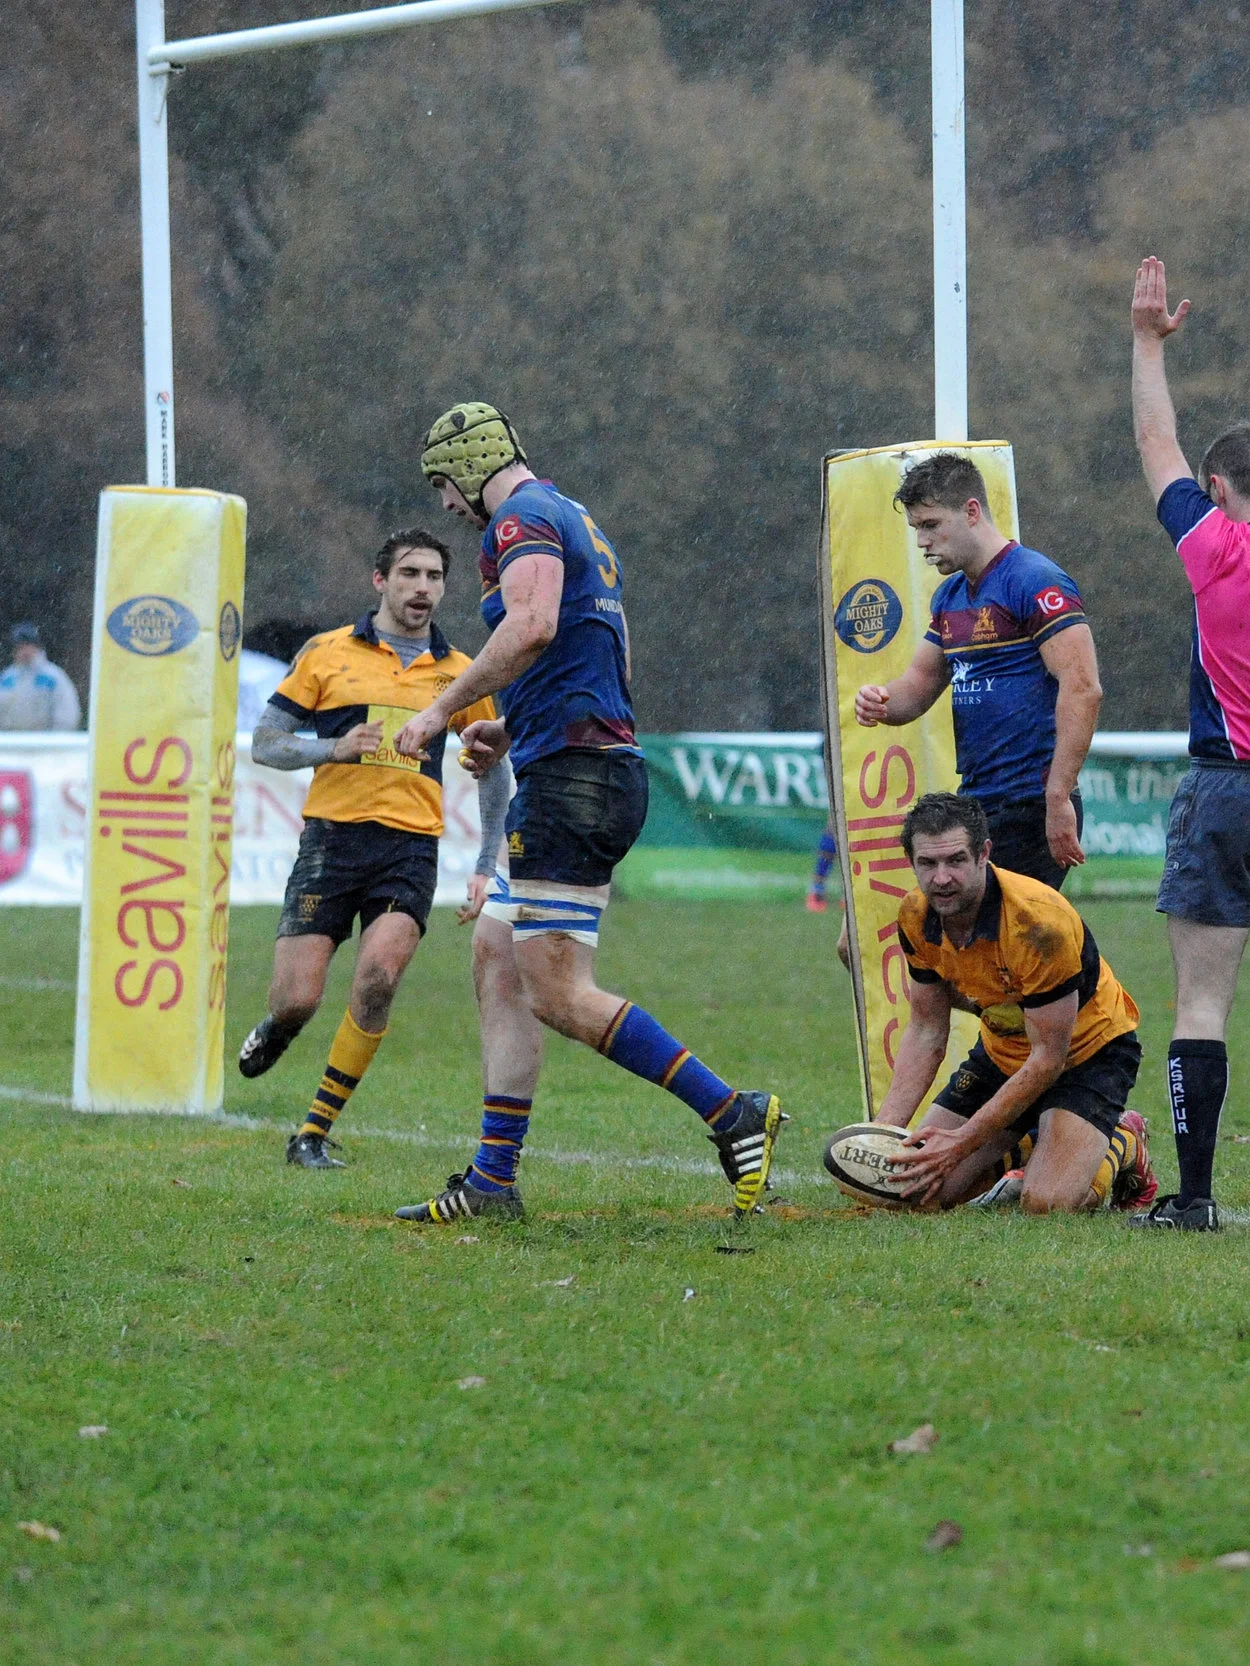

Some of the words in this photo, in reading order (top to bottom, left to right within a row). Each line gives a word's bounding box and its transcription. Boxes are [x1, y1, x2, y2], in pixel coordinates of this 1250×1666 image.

[495, 520, 519, 546] IG
[580, 512, 618, 589] 5
[846, 602, 889, 620] MIGHTY
[1037, 591, 1064, 614] IG
[122, 613, 182, 629] MIGHTY
[131, 627, 172, 639] OAKS
[854, 617, 884, 633] OAKS
[100, 736, 193, 1012] savills
[207, 740, 236, 1011] savills
[1169, 1056, 1190, 1134] KSRFUR
